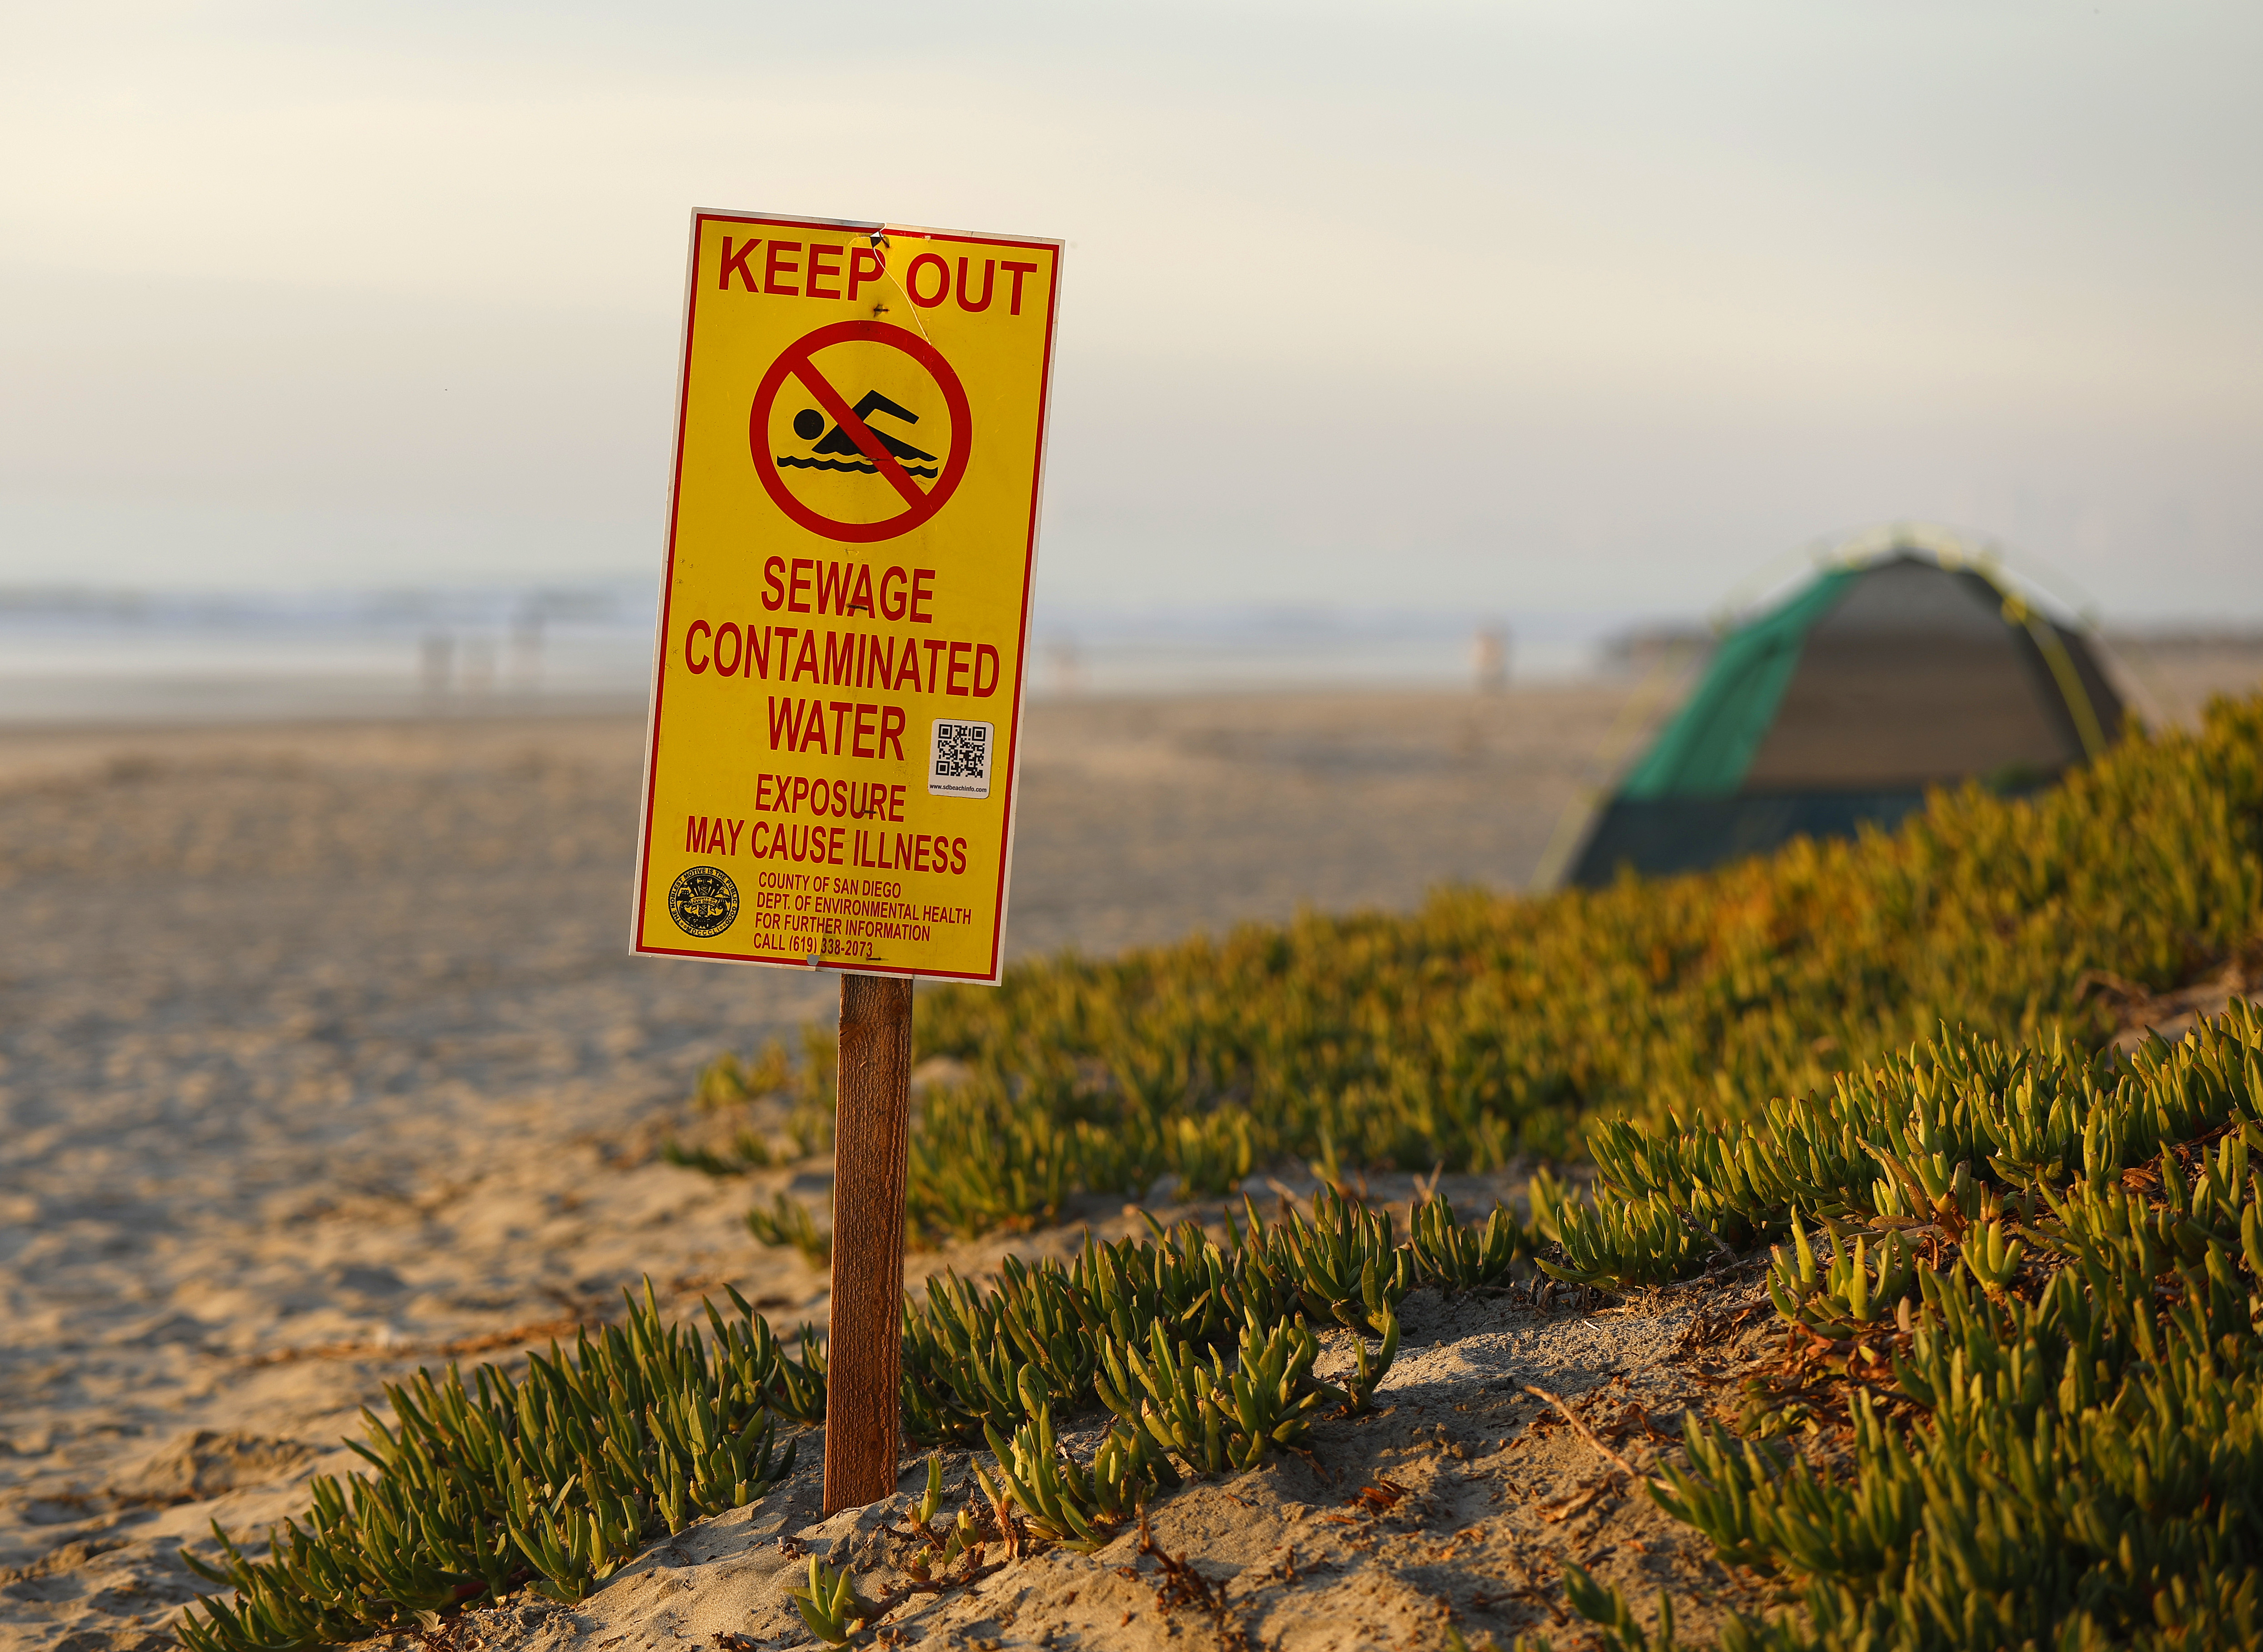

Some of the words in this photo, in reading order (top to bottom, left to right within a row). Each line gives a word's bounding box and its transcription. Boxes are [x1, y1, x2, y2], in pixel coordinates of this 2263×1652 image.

[719, 236, 886, 301] KEEP
[906, 253, 1037, 315] OUT
[761, 556, 936, 624] SEWAGE
[685, 619, 1000, 698] CONTAMINATED
[768, 696, 906, 761] WATER
[755, 773, 906, 822] EXPOSURE
[930, 784, 987, 792] www.sdbeachinfo.com
[686, 815, 745, 856] MAY
[751, 821, 846, 865] CAUSE
[853, 829, 967, 875] ILLNESS
[683, 868, 706, 879] MOTIVE
[715, 870, 726, 881] THE
[759, 871, 811, 891] COUNTY
[813, 876, 830, 893] OF
[833, 877, 859, 896] SAN
[862, 880, 901, 899] DIEGO
[670, 878, 683, 908] NOBLEST
[726, 878, 737, 904] PUBLIC
[672, 910, 682, 924] THE
[726, 906, 736, 924] GOOD
[757, 891, 791, 910] DEPT.
[795, 895, 812, 911] OF
[815, 896, 919, 921] ENVIRONMENTAL
[922, 905, 971, 925] HEALTH
[755, 912, 781, 930] FOR
[784, 914, 842, 935] FURTHER
[846, 919, 931, 942] INFORMATION
[754, 932, 786, 951] CALL
[789, 935, 817, 953] (619)
[821, 938, 873, 957] 338-2073
